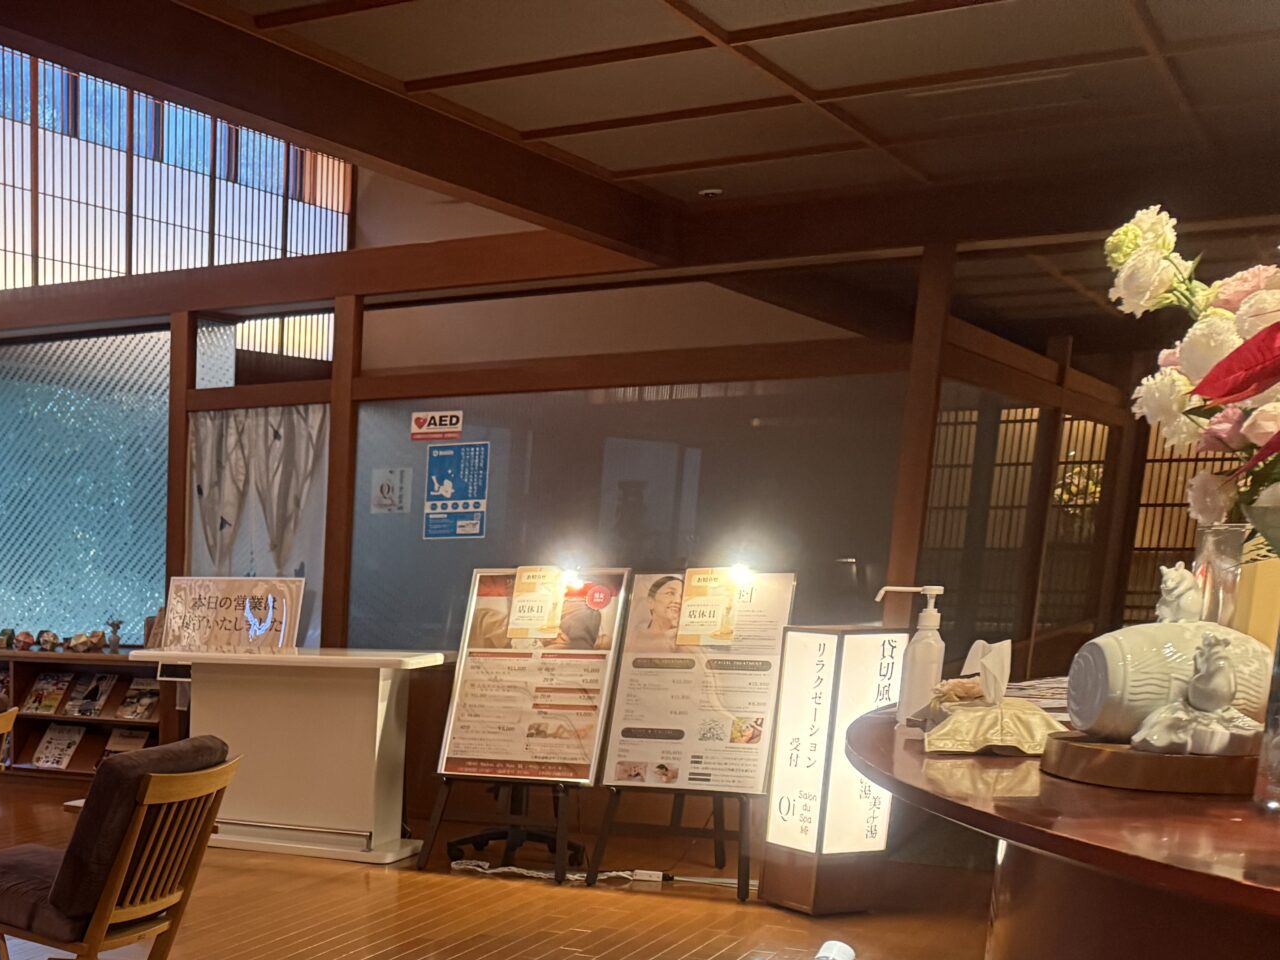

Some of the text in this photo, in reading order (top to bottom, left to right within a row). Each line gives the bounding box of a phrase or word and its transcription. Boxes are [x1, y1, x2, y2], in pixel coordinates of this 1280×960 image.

[426, 414, 461, 428] AED
[875, 638, 897, 709] 貸切風
[806, 642, 826, 769] リラクゼーション
[790, 737, 800, 768] 受付
[798, 789, 817, 802] Salon
[779, 796, 796, 822] Qi
[803, 803, 811, 812] du
[799, 813, 812, 824] Spa
